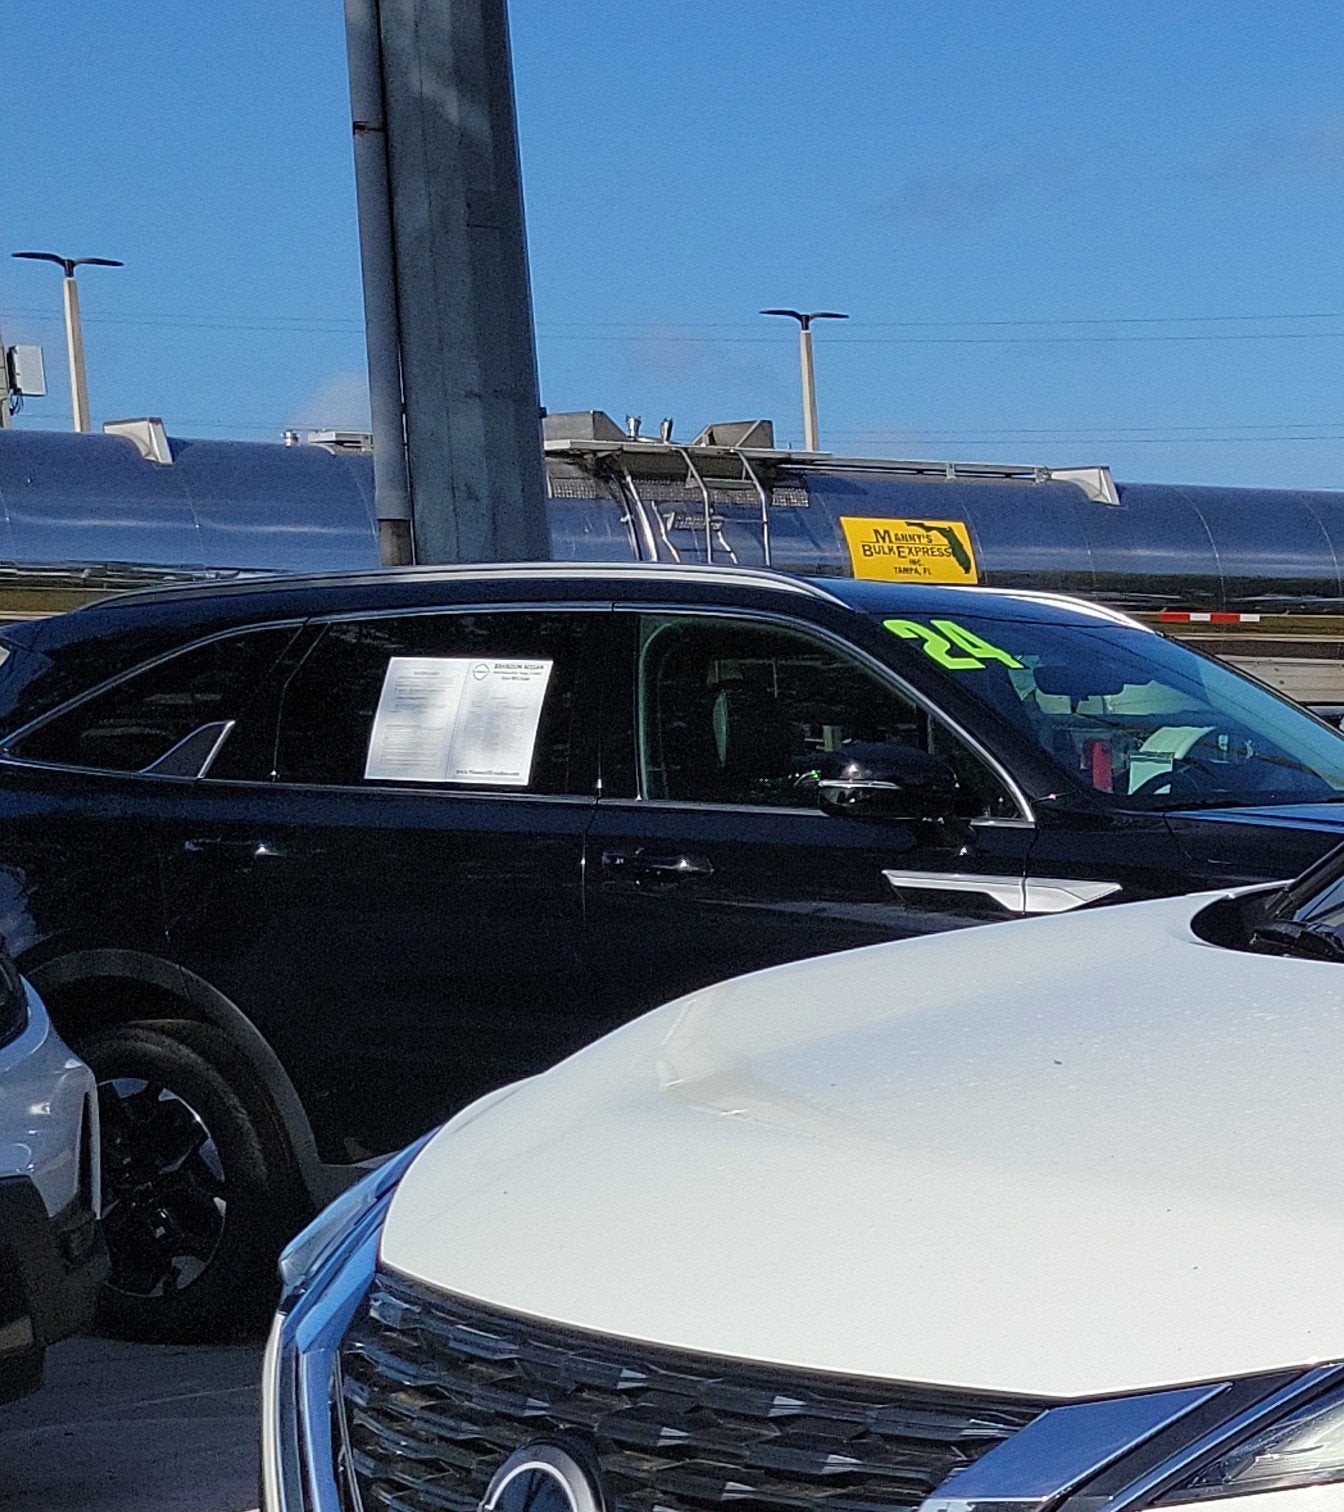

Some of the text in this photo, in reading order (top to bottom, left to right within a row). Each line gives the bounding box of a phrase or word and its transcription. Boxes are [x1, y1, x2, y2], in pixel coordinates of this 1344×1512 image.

[872, 528, 934, 544] MANNY'S
[861, 544, 952, 559] BULK EXPRESS
[883, 619, 1025, 670] 24
